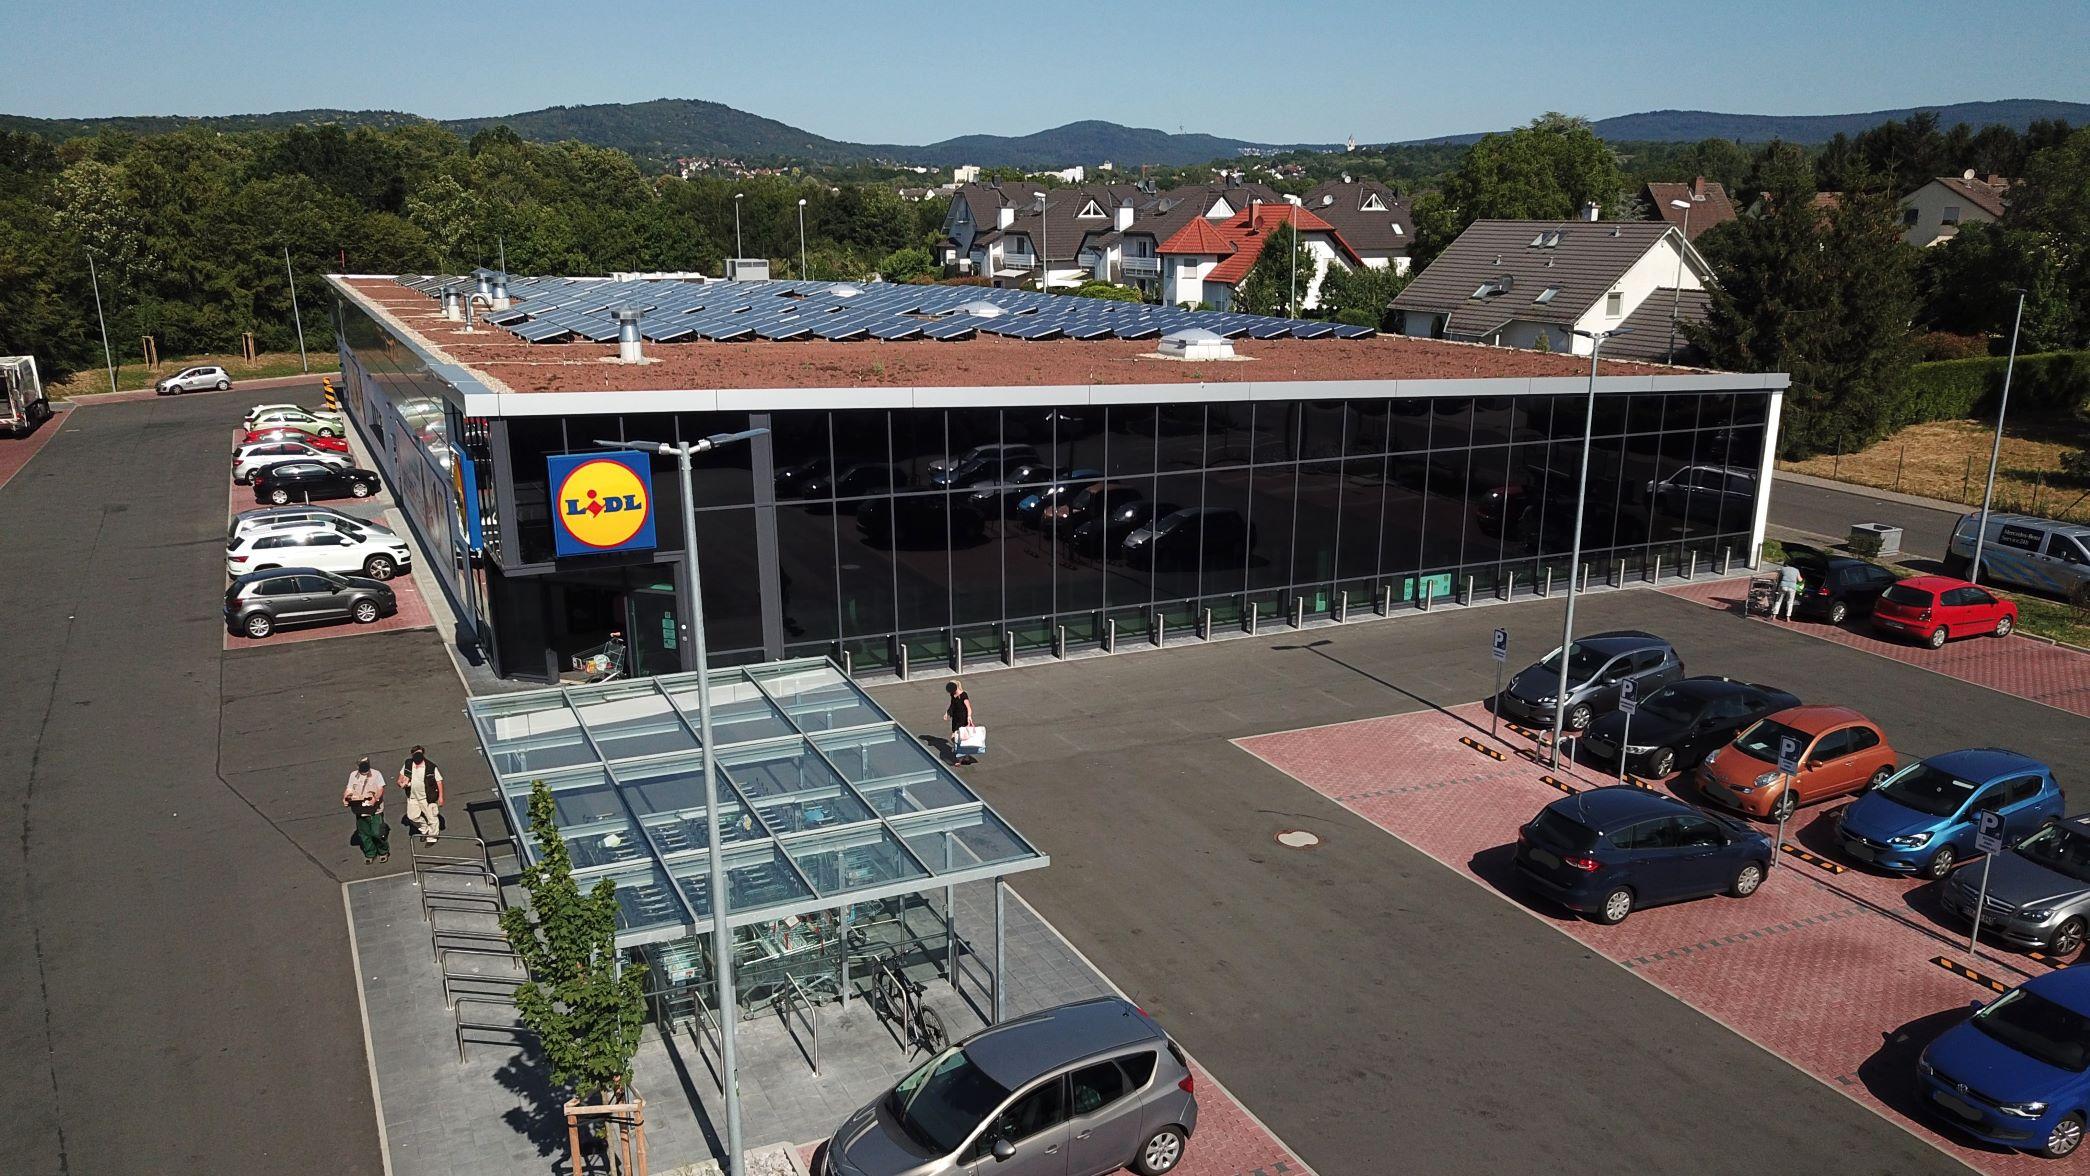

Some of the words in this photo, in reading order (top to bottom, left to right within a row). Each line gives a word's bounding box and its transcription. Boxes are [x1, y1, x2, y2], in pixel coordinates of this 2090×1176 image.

[1495, 631, 1504, 647] P
[1621, 680, 1634, 698] P
[1780, 738, 1796, 758] P
[1980, 811, 1999, 833] P
